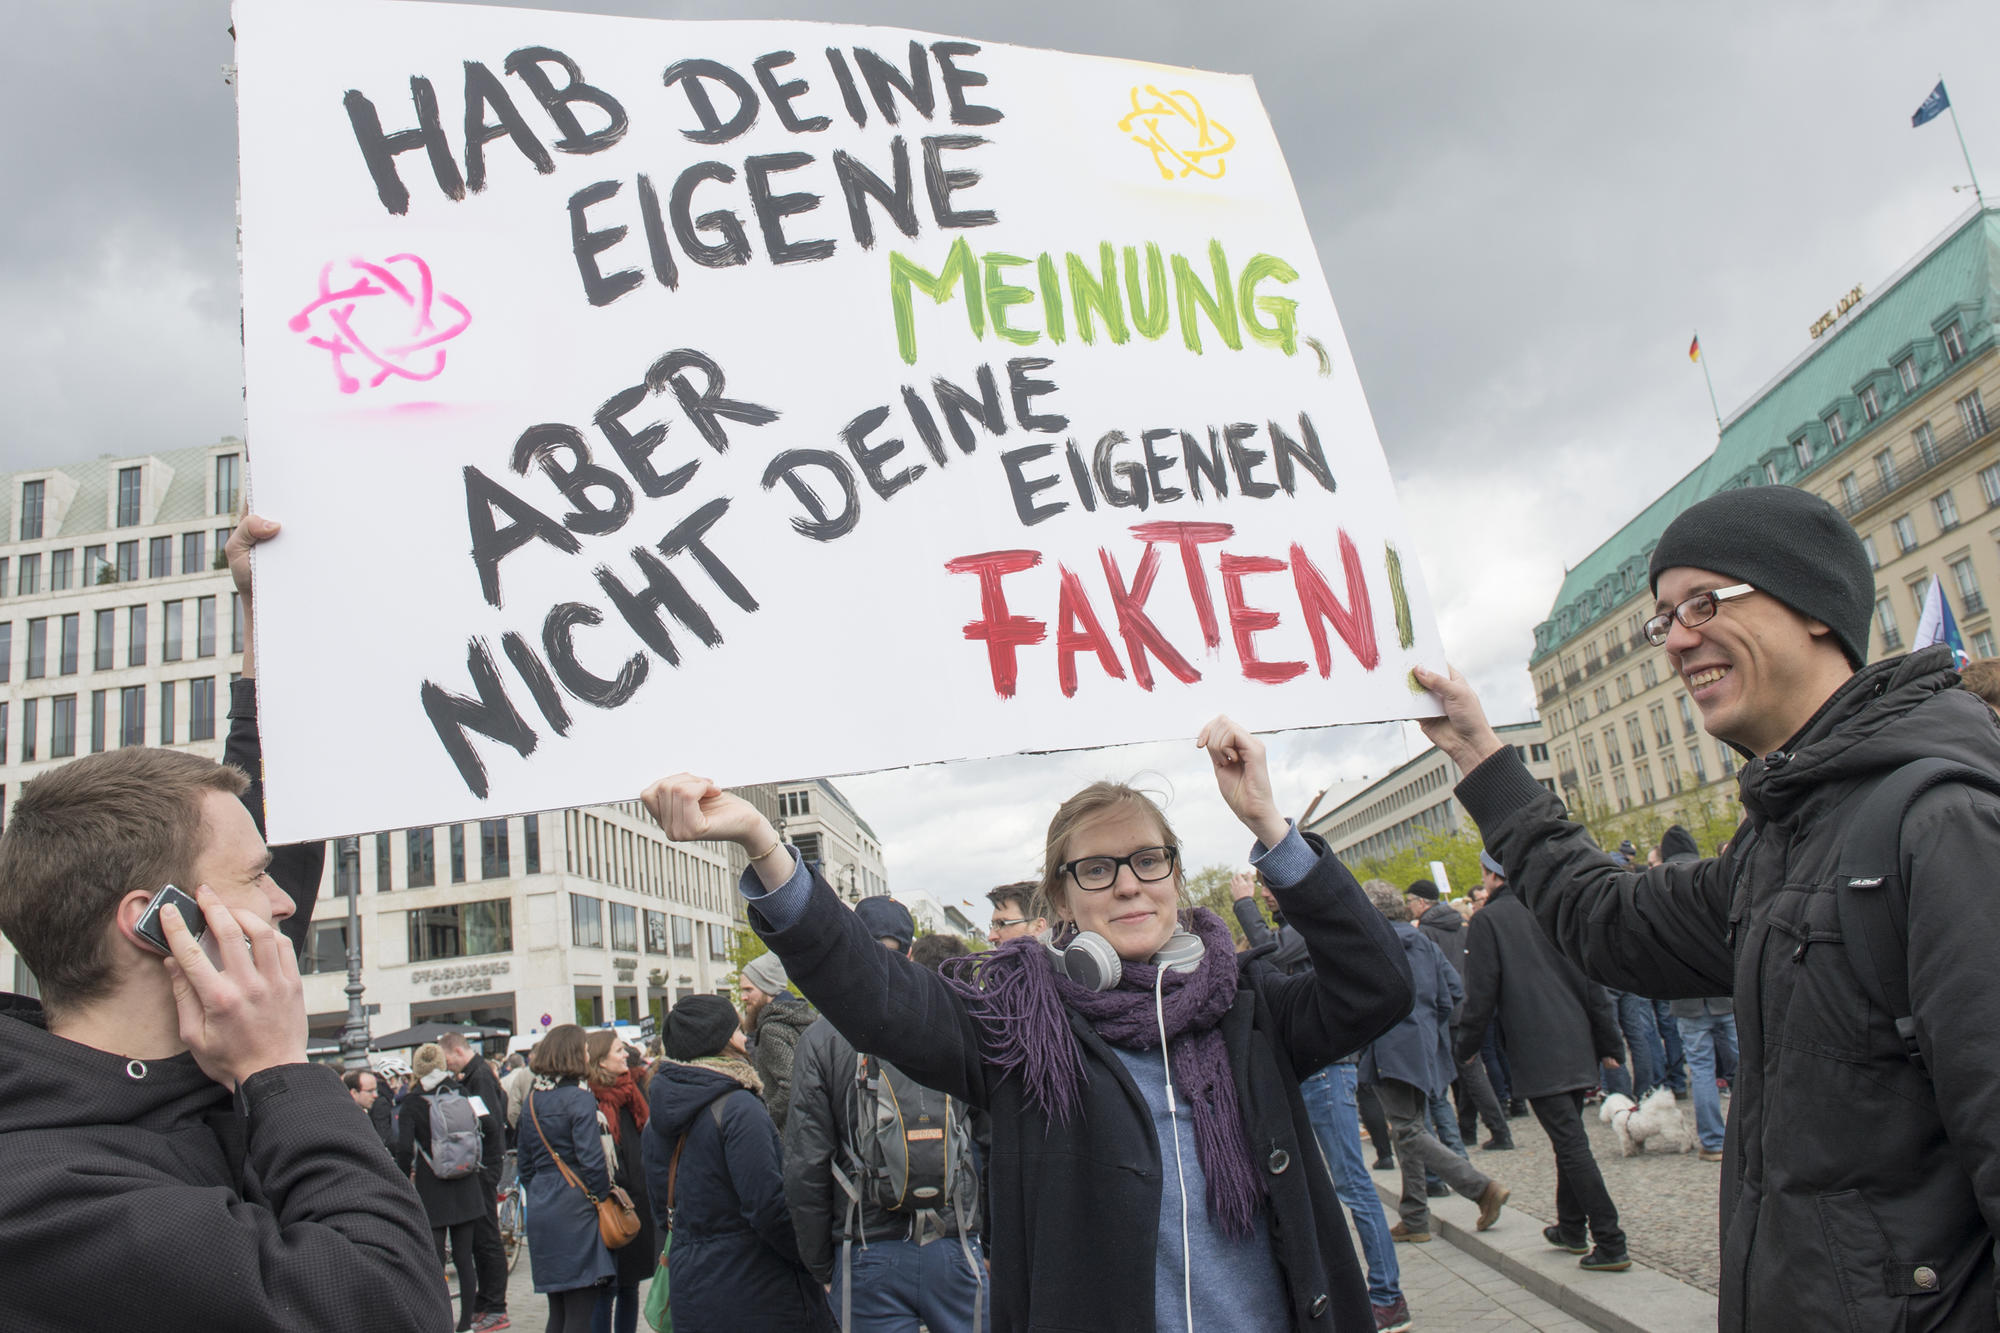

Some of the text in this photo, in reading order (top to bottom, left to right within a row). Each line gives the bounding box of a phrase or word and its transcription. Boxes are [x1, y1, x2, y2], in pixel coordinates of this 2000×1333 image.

[342, 39, 1004, 217] HAB DEINE
[566, 133, 1001, 307] EIGENE
[889, 235, 1331, 377] MEINUNG,
[463, 348, 781, 610] ABER
[1000, 411, 1337, 527] EIGENEN
[420, 356, 1071, 800] NICHT DEINE
[944, 520, 1428, 700] FAKTEN!
[411, 961, 511, 984] STARBUCKS
[430, 978, 492, 997] COFFEE
